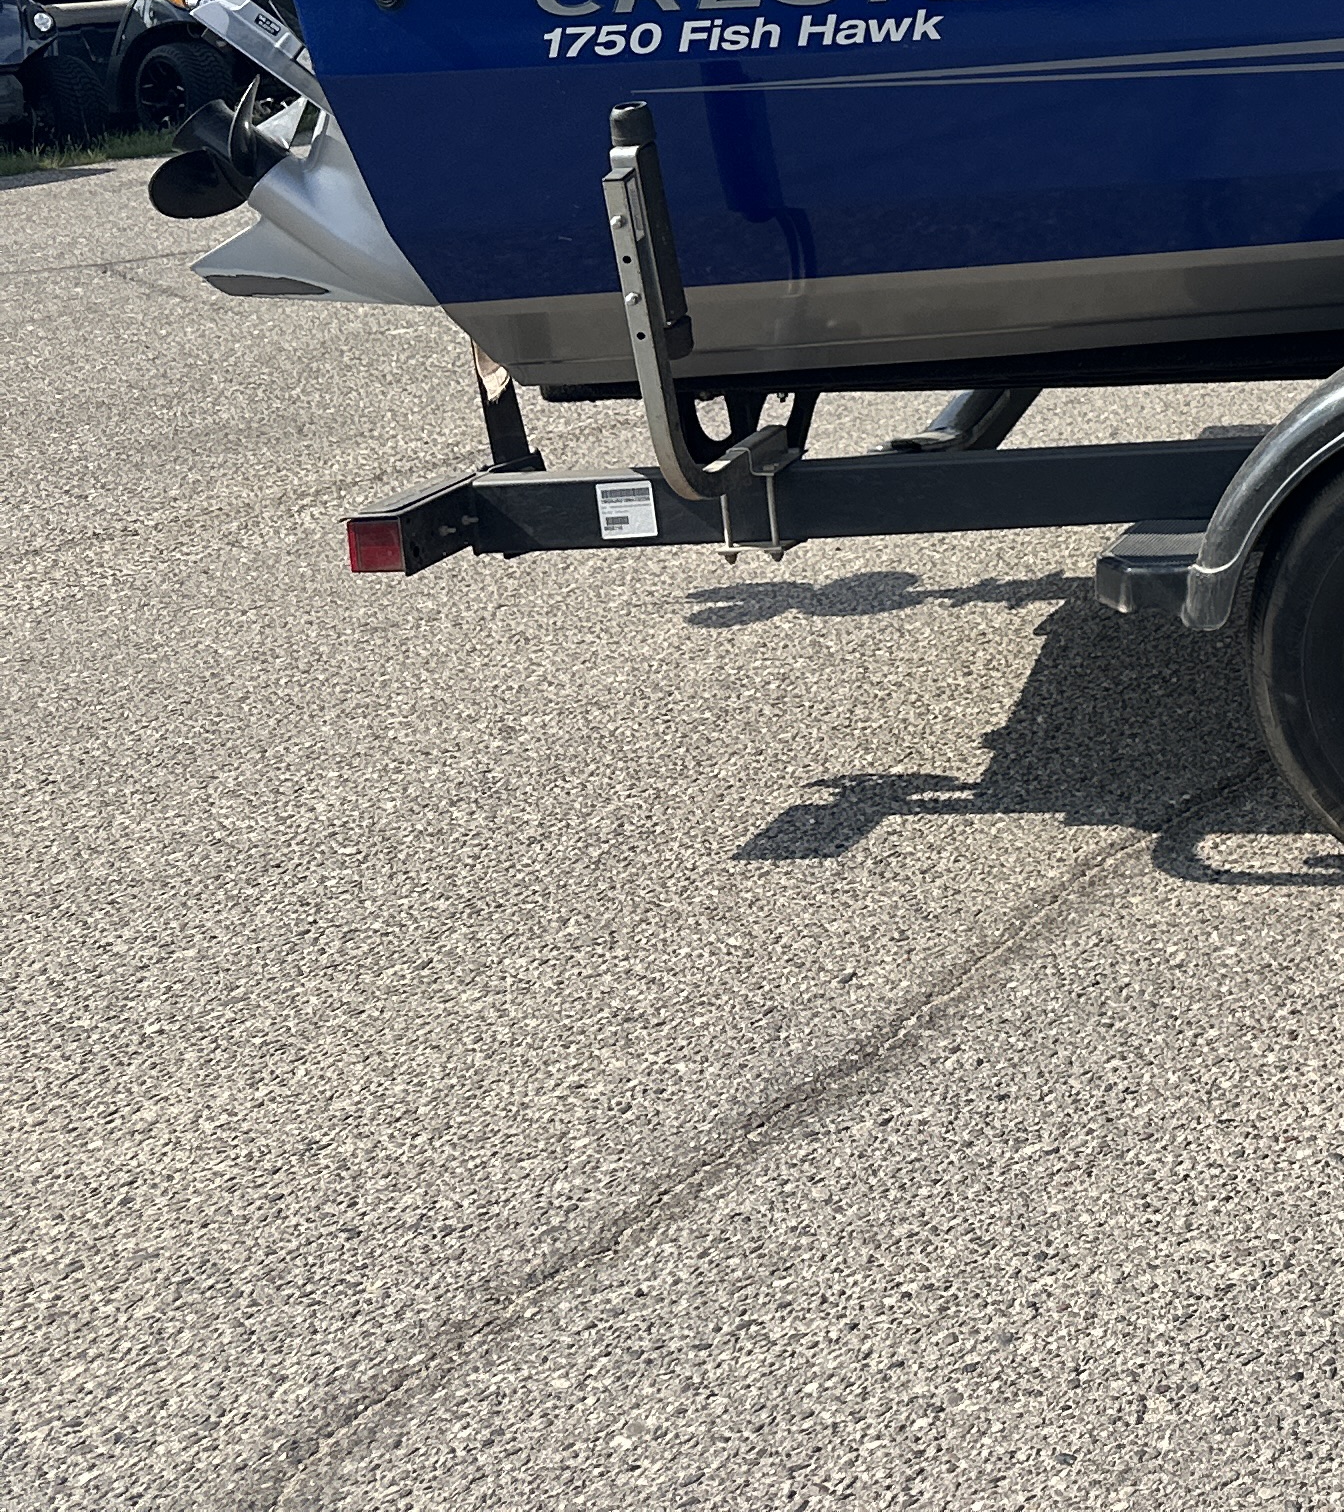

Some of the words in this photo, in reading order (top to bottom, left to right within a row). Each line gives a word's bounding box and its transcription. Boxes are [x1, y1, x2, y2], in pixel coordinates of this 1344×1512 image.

[542, 22, 663, 59] 1750
[679, 15, 781, 54] Fish
[798, 9, 942, 47] Hawk
